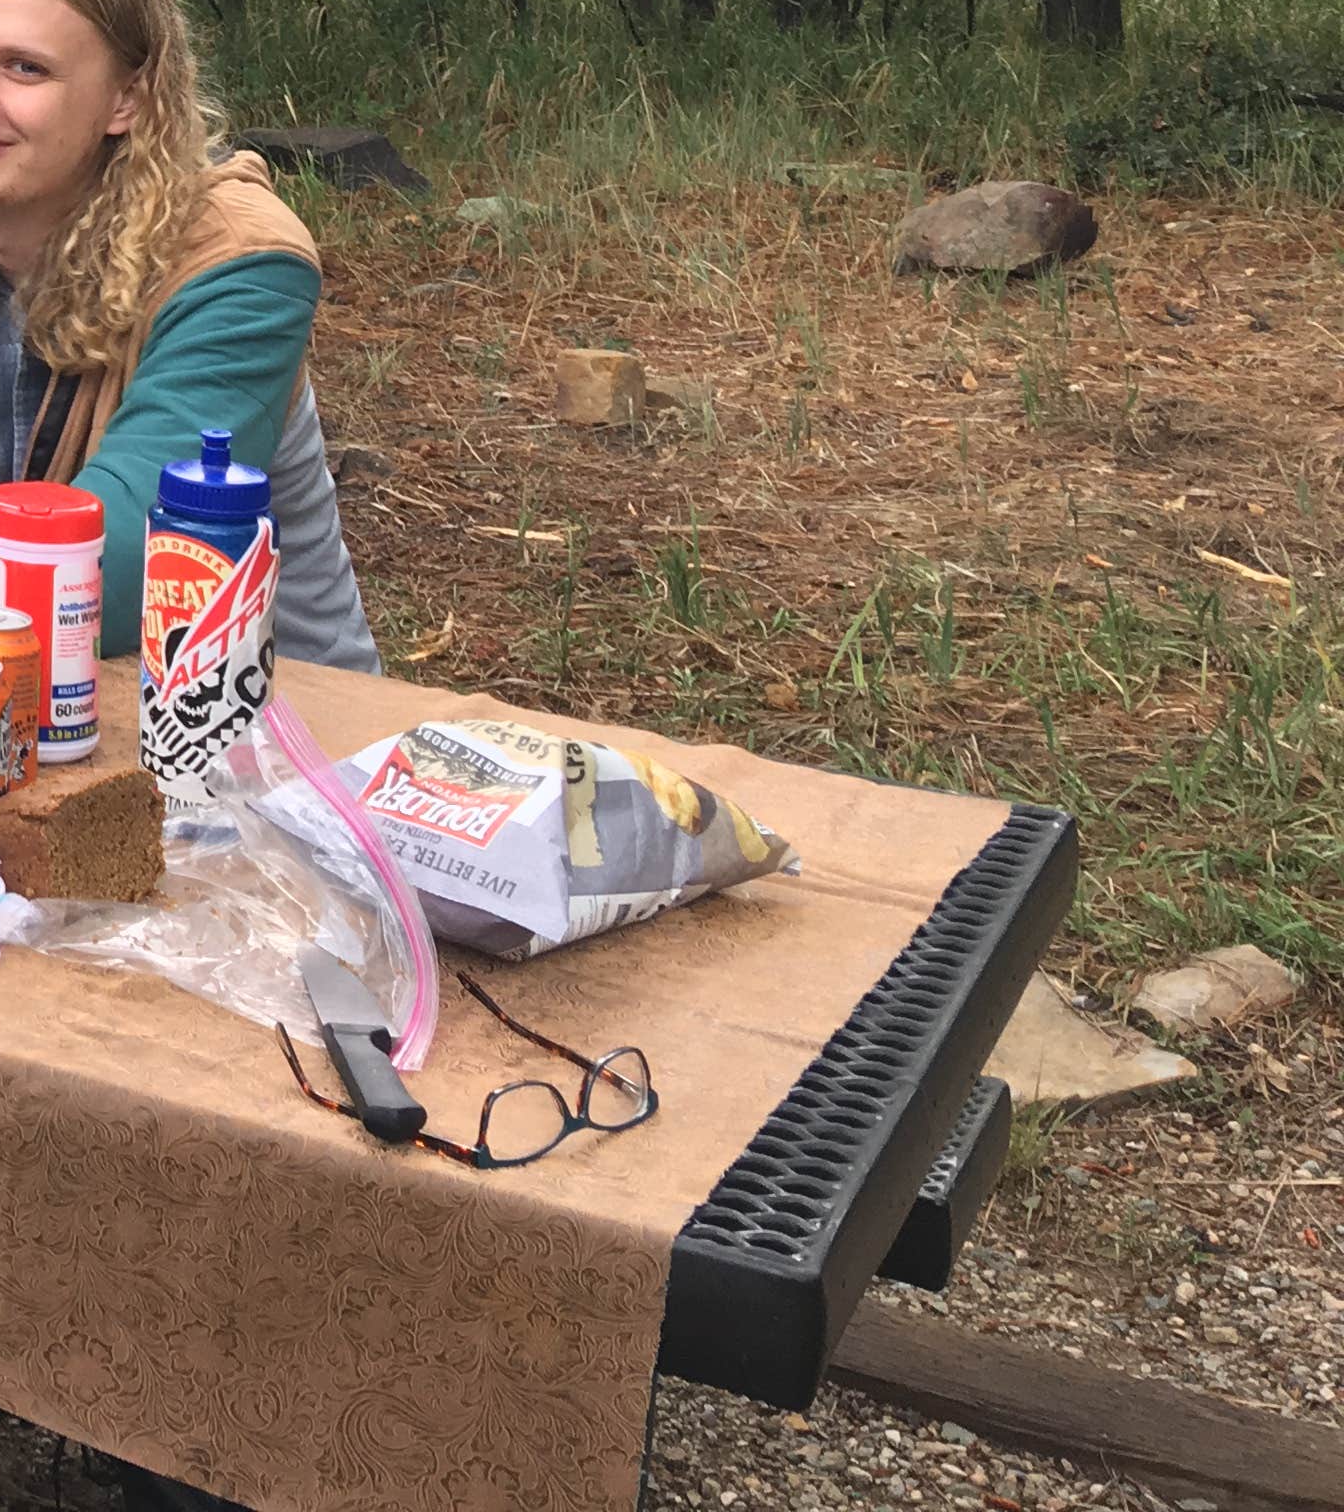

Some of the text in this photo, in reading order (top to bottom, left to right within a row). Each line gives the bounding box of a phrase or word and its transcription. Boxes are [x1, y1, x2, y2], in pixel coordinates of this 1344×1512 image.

[171, 539, 226, 572] DRINK
[145, 577, 218, 613] GREAT
[58, 613, 79, 626] Wet
[55, 703, 72, 718] 60
[415, 726, 539, 786] AUTHENTIC FOODS
[366, 764, 512, 841] BOULDER
[477, 866, 518, 899] LIVE
